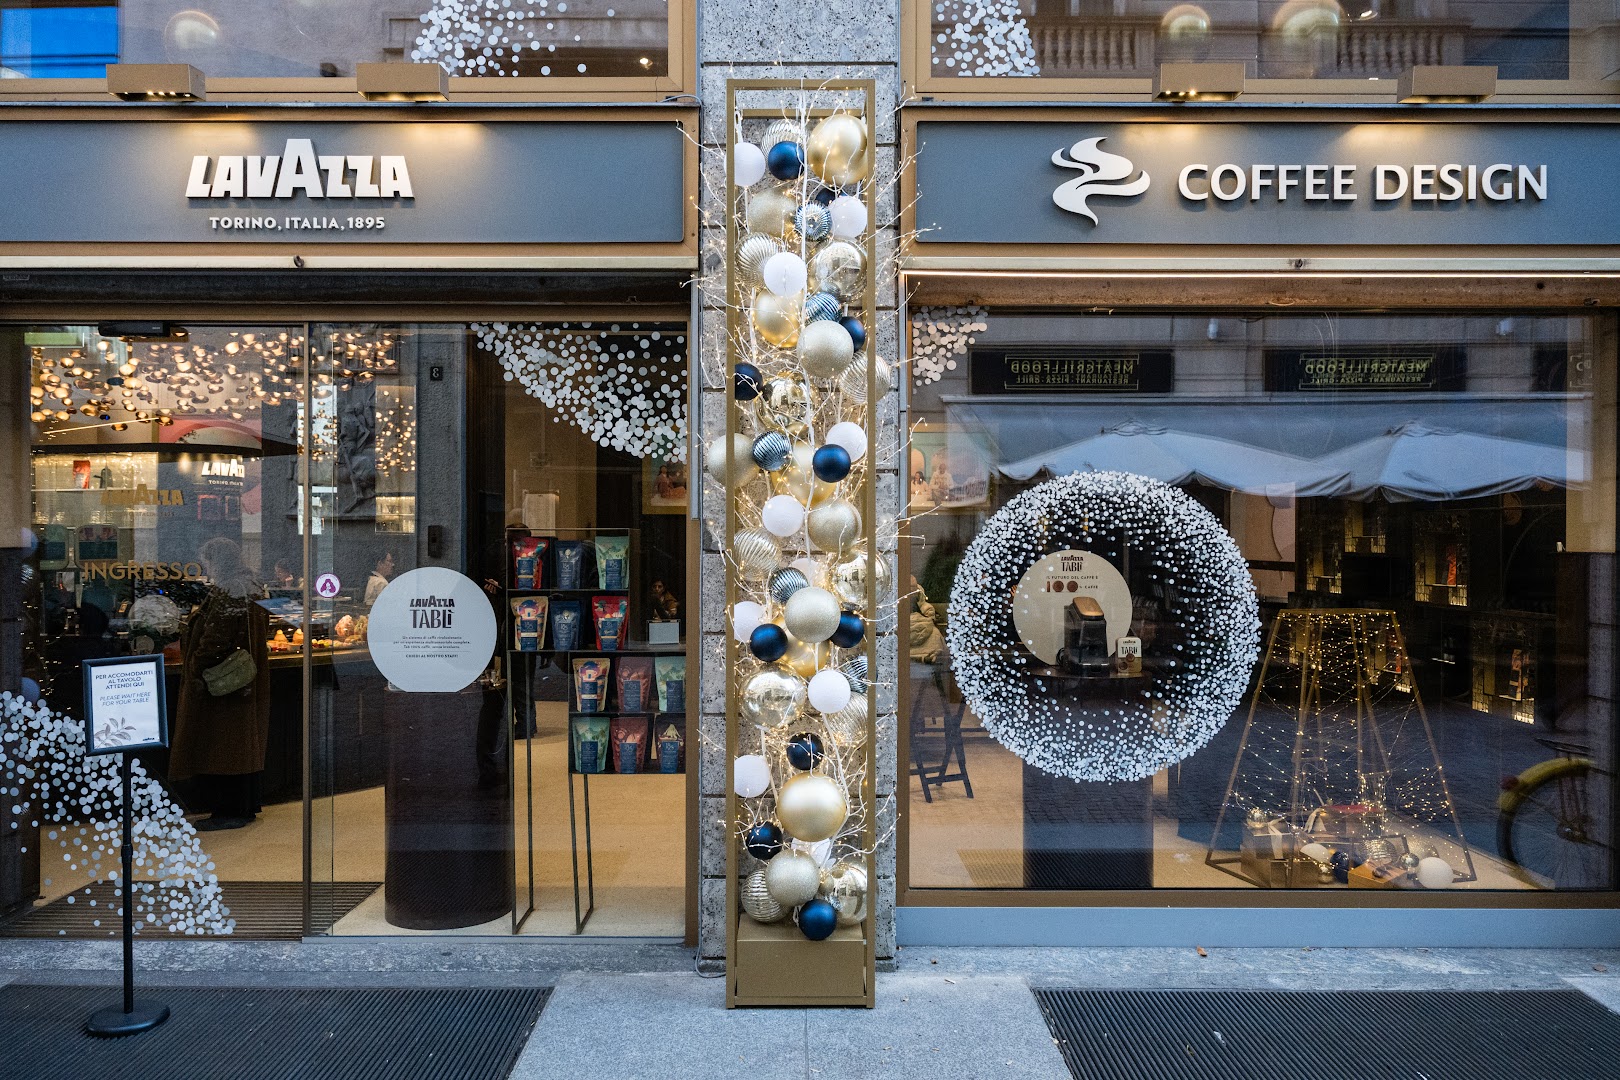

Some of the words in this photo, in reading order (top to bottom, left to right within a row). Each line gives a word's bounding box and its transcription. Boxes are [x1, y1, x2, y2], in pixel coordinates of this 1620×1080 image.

[185, 138, 415, 199] LAVAZZA
[1178, 164, 1358, 201] COFFEE
[1375, 163, 1548, 201] DESIGN
[209, 217, 282, 231] TORINO,
[285, 217, 345, 231] ITALIA,
[347, 217, 386, 229] 1895
[84, 561, 202, 581] INGRESSO
[410, 595, 455, 608] LAVAZZA
[107, 670, 154, 679] ACCOMODARTI
